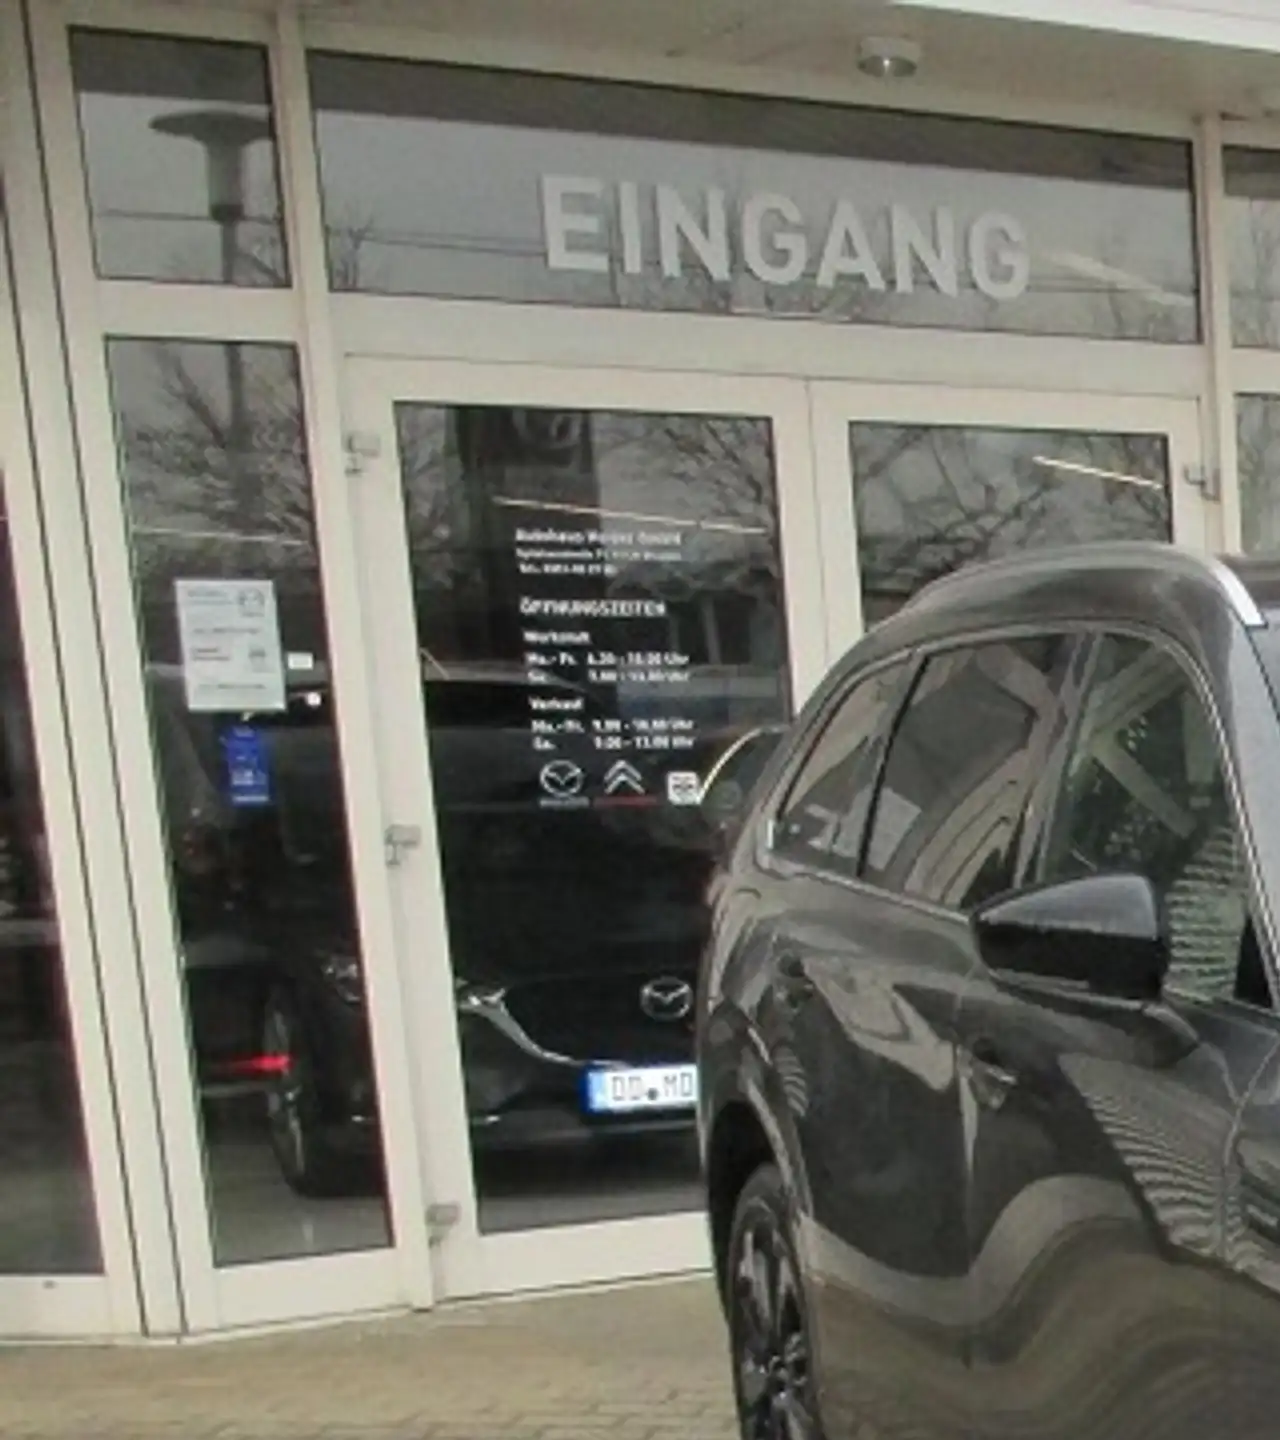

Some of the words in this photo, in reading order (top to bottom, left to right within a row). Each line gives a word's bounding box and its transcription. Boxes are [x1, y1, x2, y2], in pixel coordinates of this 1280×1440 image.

[542, 175, 1031, 300] EINGANG
[519, 596, 666, 617] ÖFFNUNGSZEITEN
[523, 631, 591, 645] Werkstatt
[528, 696, 584, 711] Verkauf
